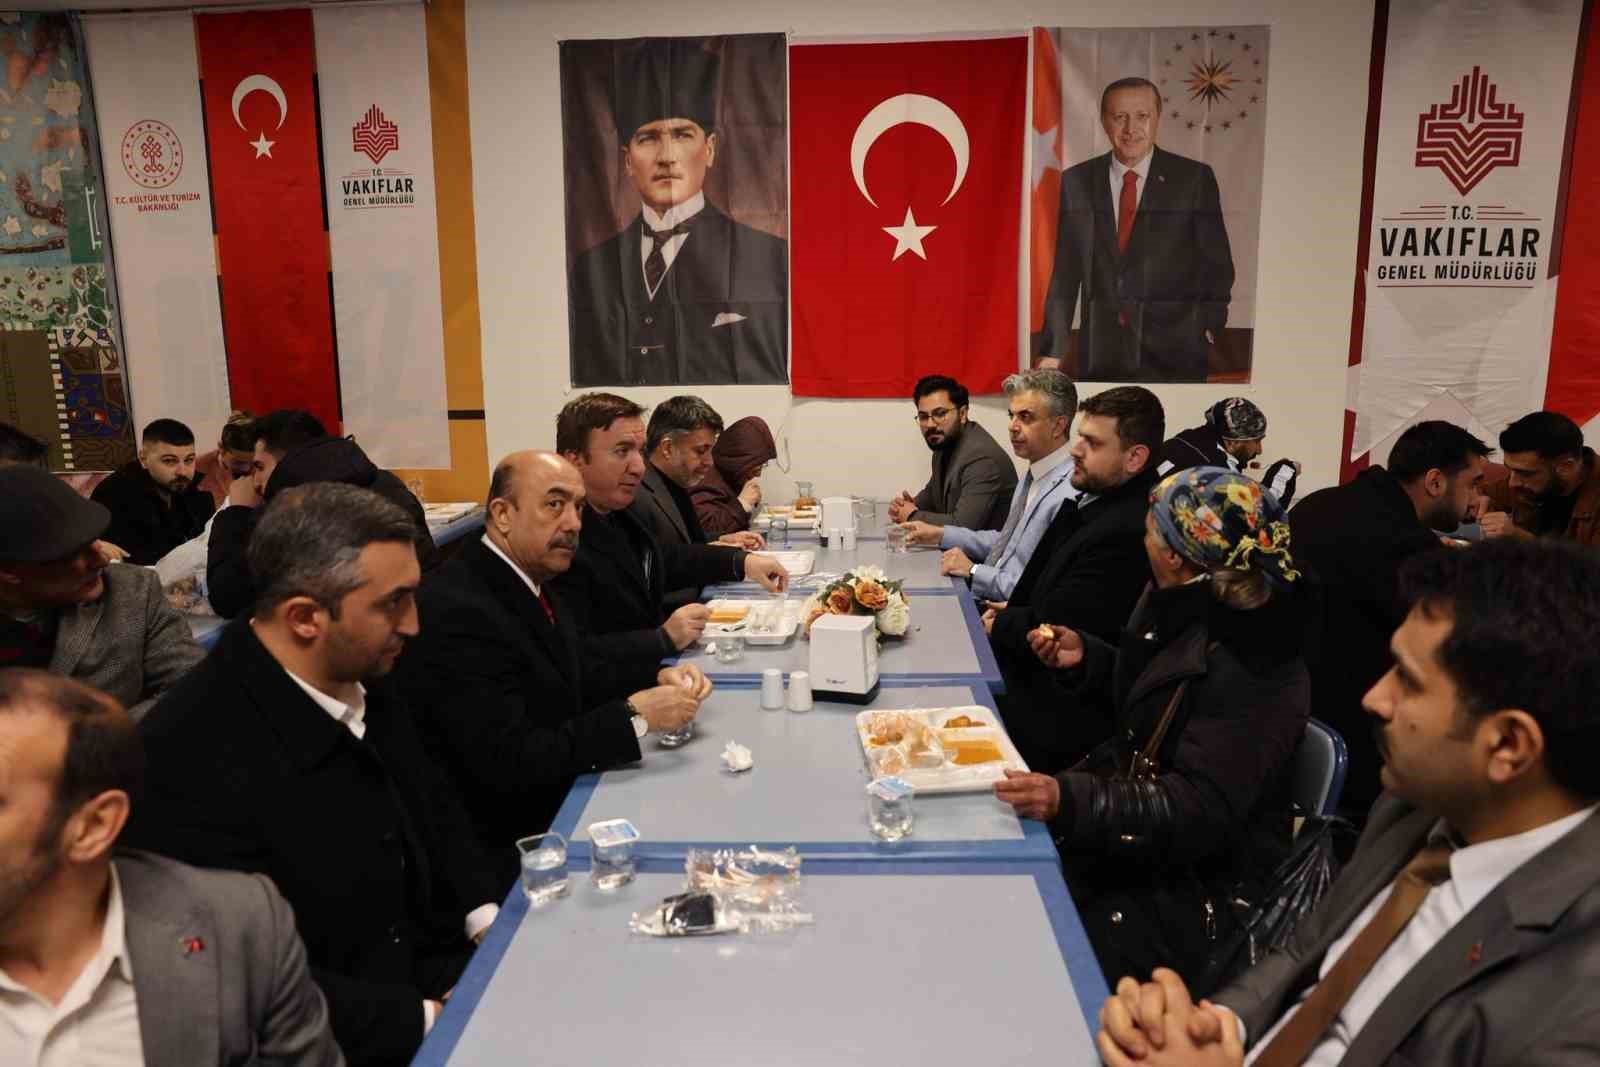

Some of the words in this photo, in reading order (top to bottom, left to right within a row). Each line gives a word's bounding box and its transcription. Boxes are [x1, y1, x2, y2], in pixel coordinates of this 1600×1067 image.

[342, 178, 414, 195] VAKIFLAR
[160, 193, 170, 202] VE
[343, 198, 366, 206] GENEL
[1451, 205, 1474, 221] T.C.
[1380, 227, 1541, 257] VAKIFLAR
[1377, 265, 1427, 280] GENEL
[1434, 261, 1537, 280] MÜDÜRLÜĞÜ
